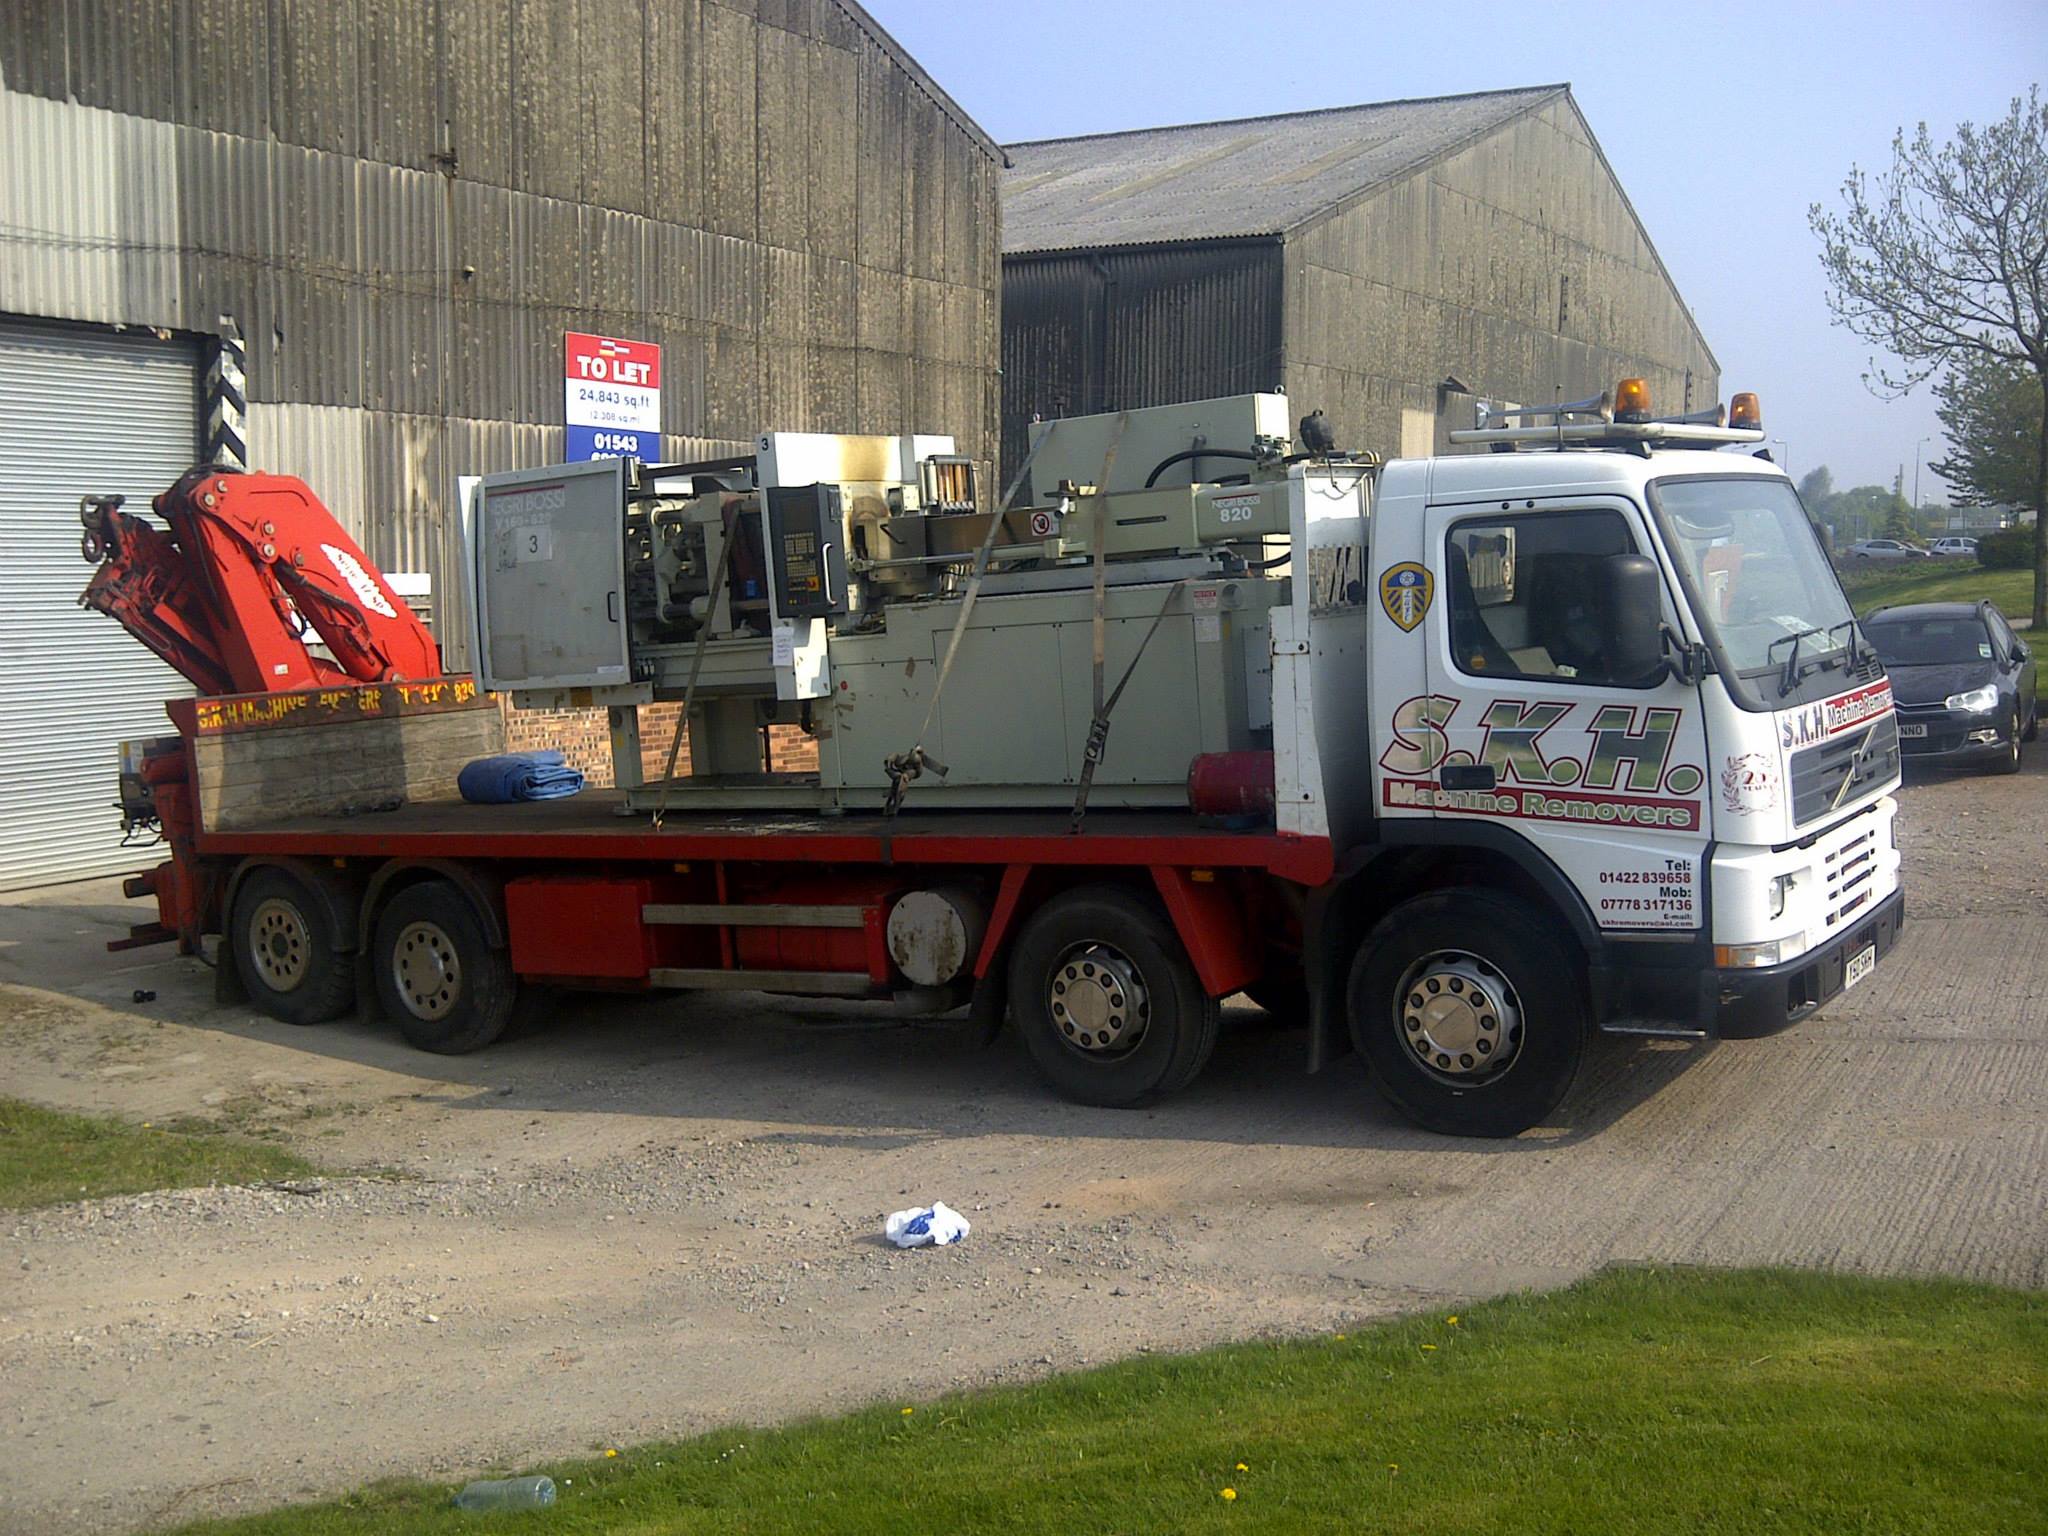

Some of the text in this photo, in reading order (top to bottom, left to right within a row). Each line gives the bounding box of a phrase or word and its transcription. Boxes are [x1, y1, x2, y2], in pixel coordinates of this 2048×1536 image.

[577, 355, 651, 384] TO LET
[594, 433, 638, 451] 01543
[761, 438, 769, 451] 3
[1220, 506, 1252, 522] 820
[529, 535, 538, 554] 3
[1522, 791, 1691, 826] Removers
[1665, 860, 1691, 871] Tel:
[1600, 872, 1692, 884] 01422 839658
[1660, 886, 1692, 898] Mob:
[1601, 899, 1693, 911] 07778 317136
